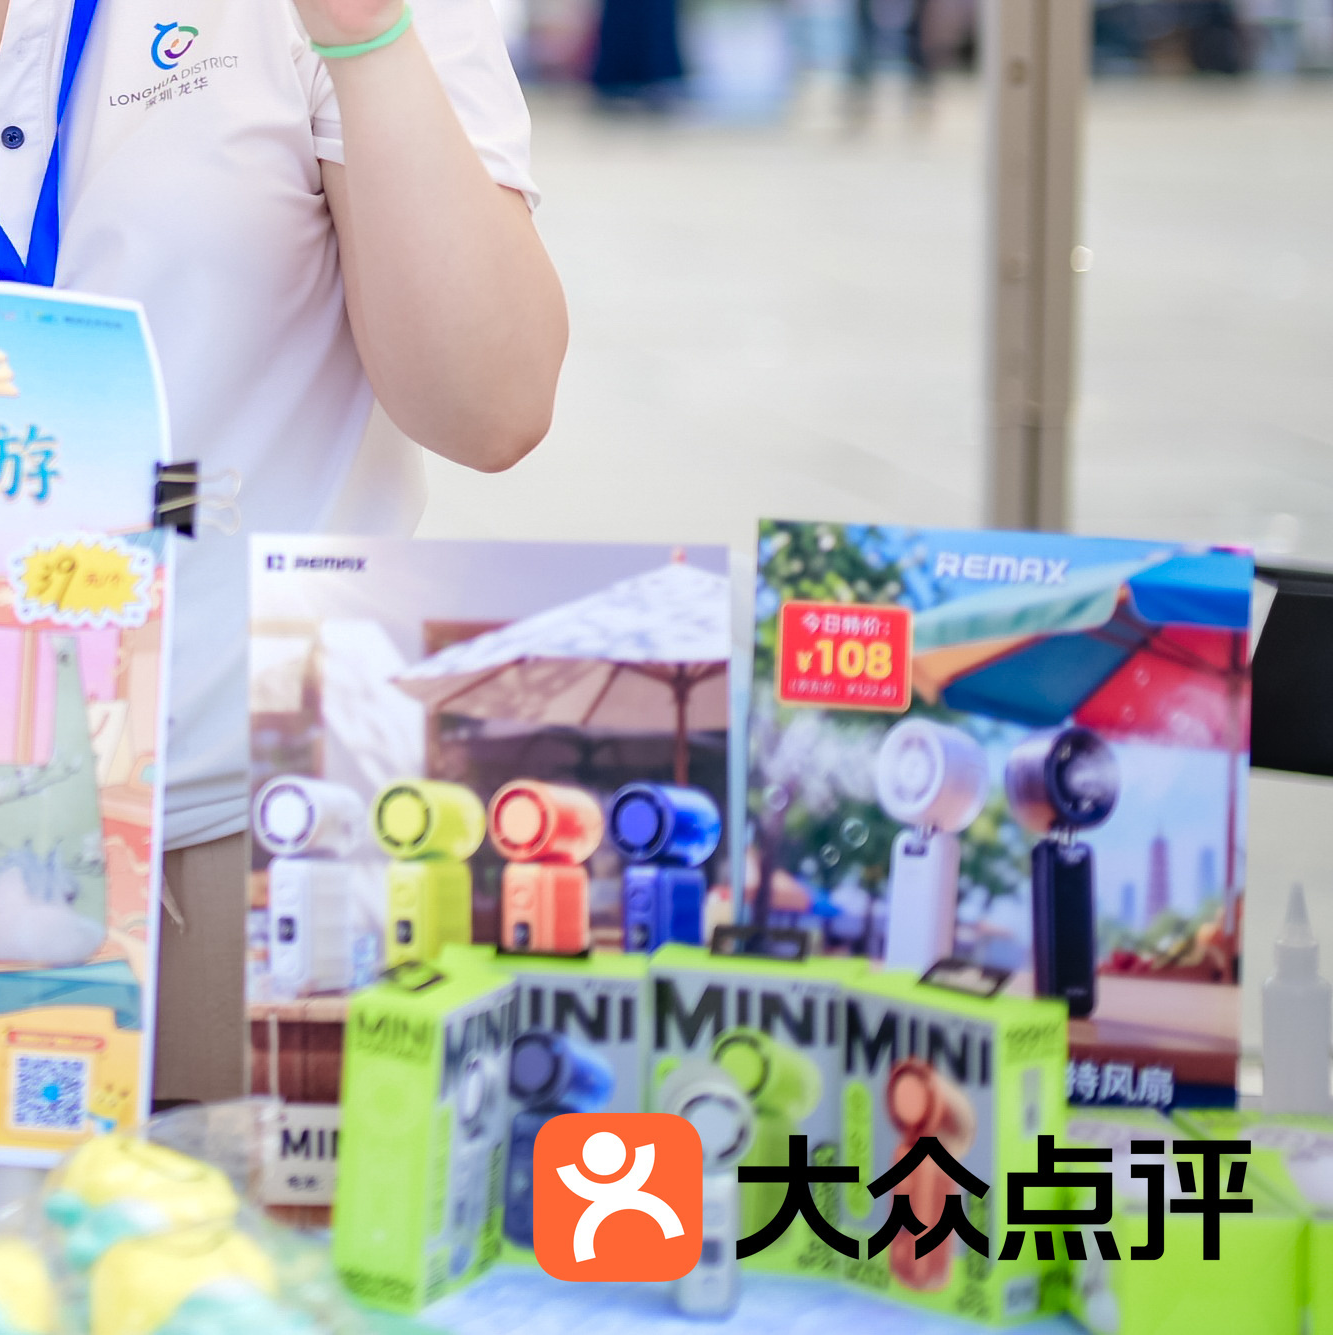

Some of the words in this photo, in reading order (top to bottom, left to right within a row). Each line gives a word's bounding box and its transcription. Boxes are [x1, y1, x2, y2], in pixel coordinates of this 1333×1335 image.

[109, 74, 178, 106] LONGHUA
[181, 55, 239, 79] DISTRICT
[934, 551, 1070, 585] REMAX
[796, 639, 893, 680] ¥108
[517, 986, 636, 1044] INI
[653, 977, 838, 1051] MINI
[844, 998, 992, 1088] MINI
